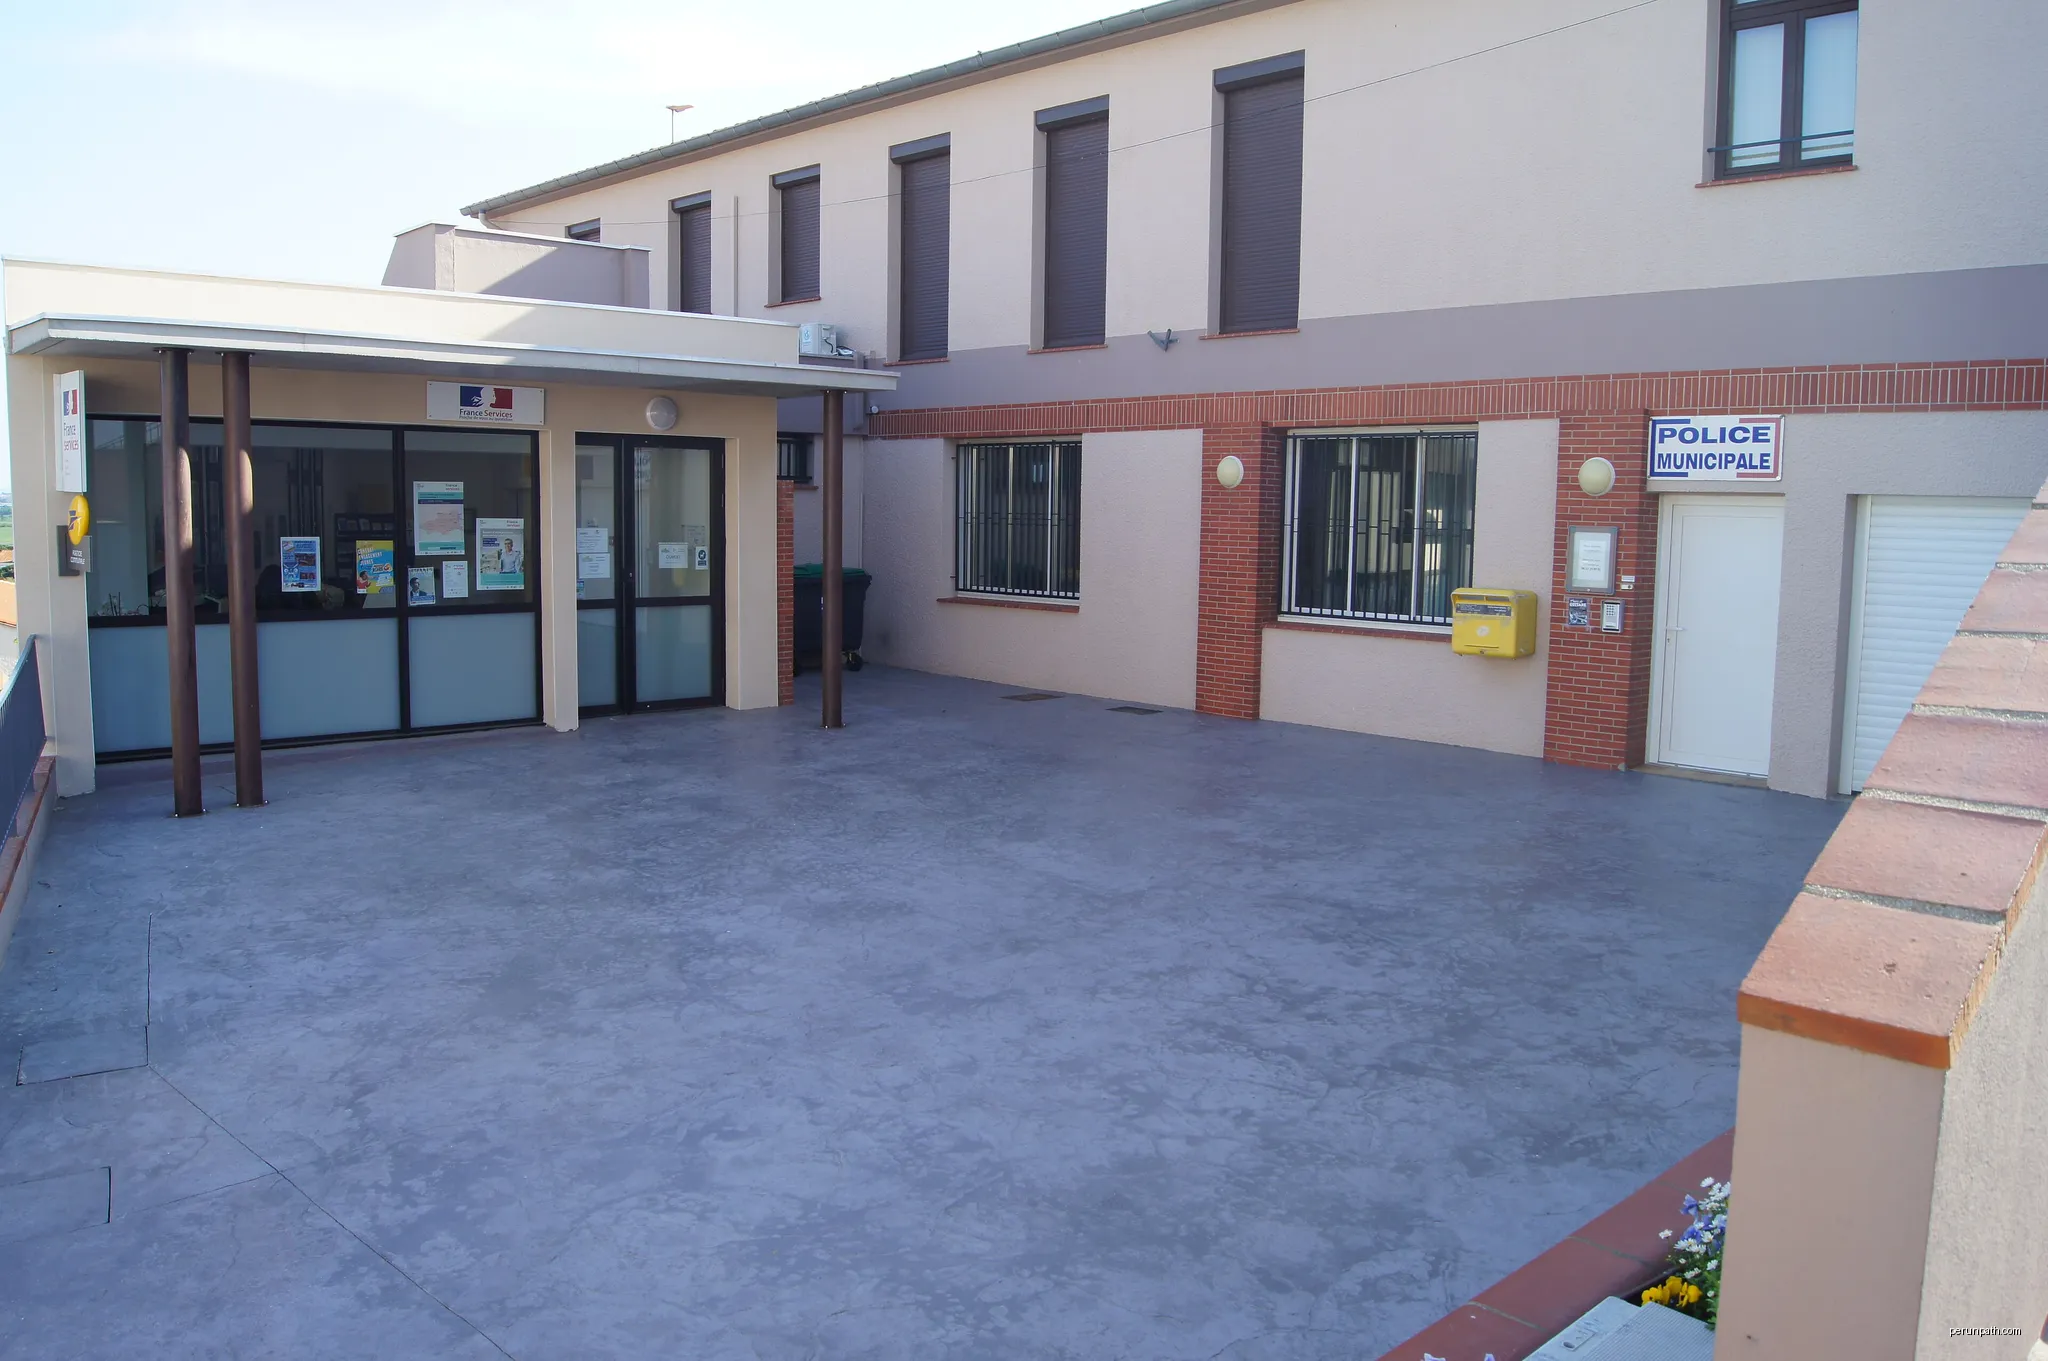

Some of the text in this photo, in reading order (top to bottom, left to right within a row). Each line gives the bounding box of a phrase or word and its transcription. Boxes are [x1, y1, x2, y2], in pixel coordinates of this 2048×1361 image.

[460, 408, 513, 418] France Services
[63, 422, 76, 437] France
[1658, 426, 1771, 444] POLICE
[63, 440, 79, 451] services
[1657, 452, 1771, 470] MUNICIPALE
